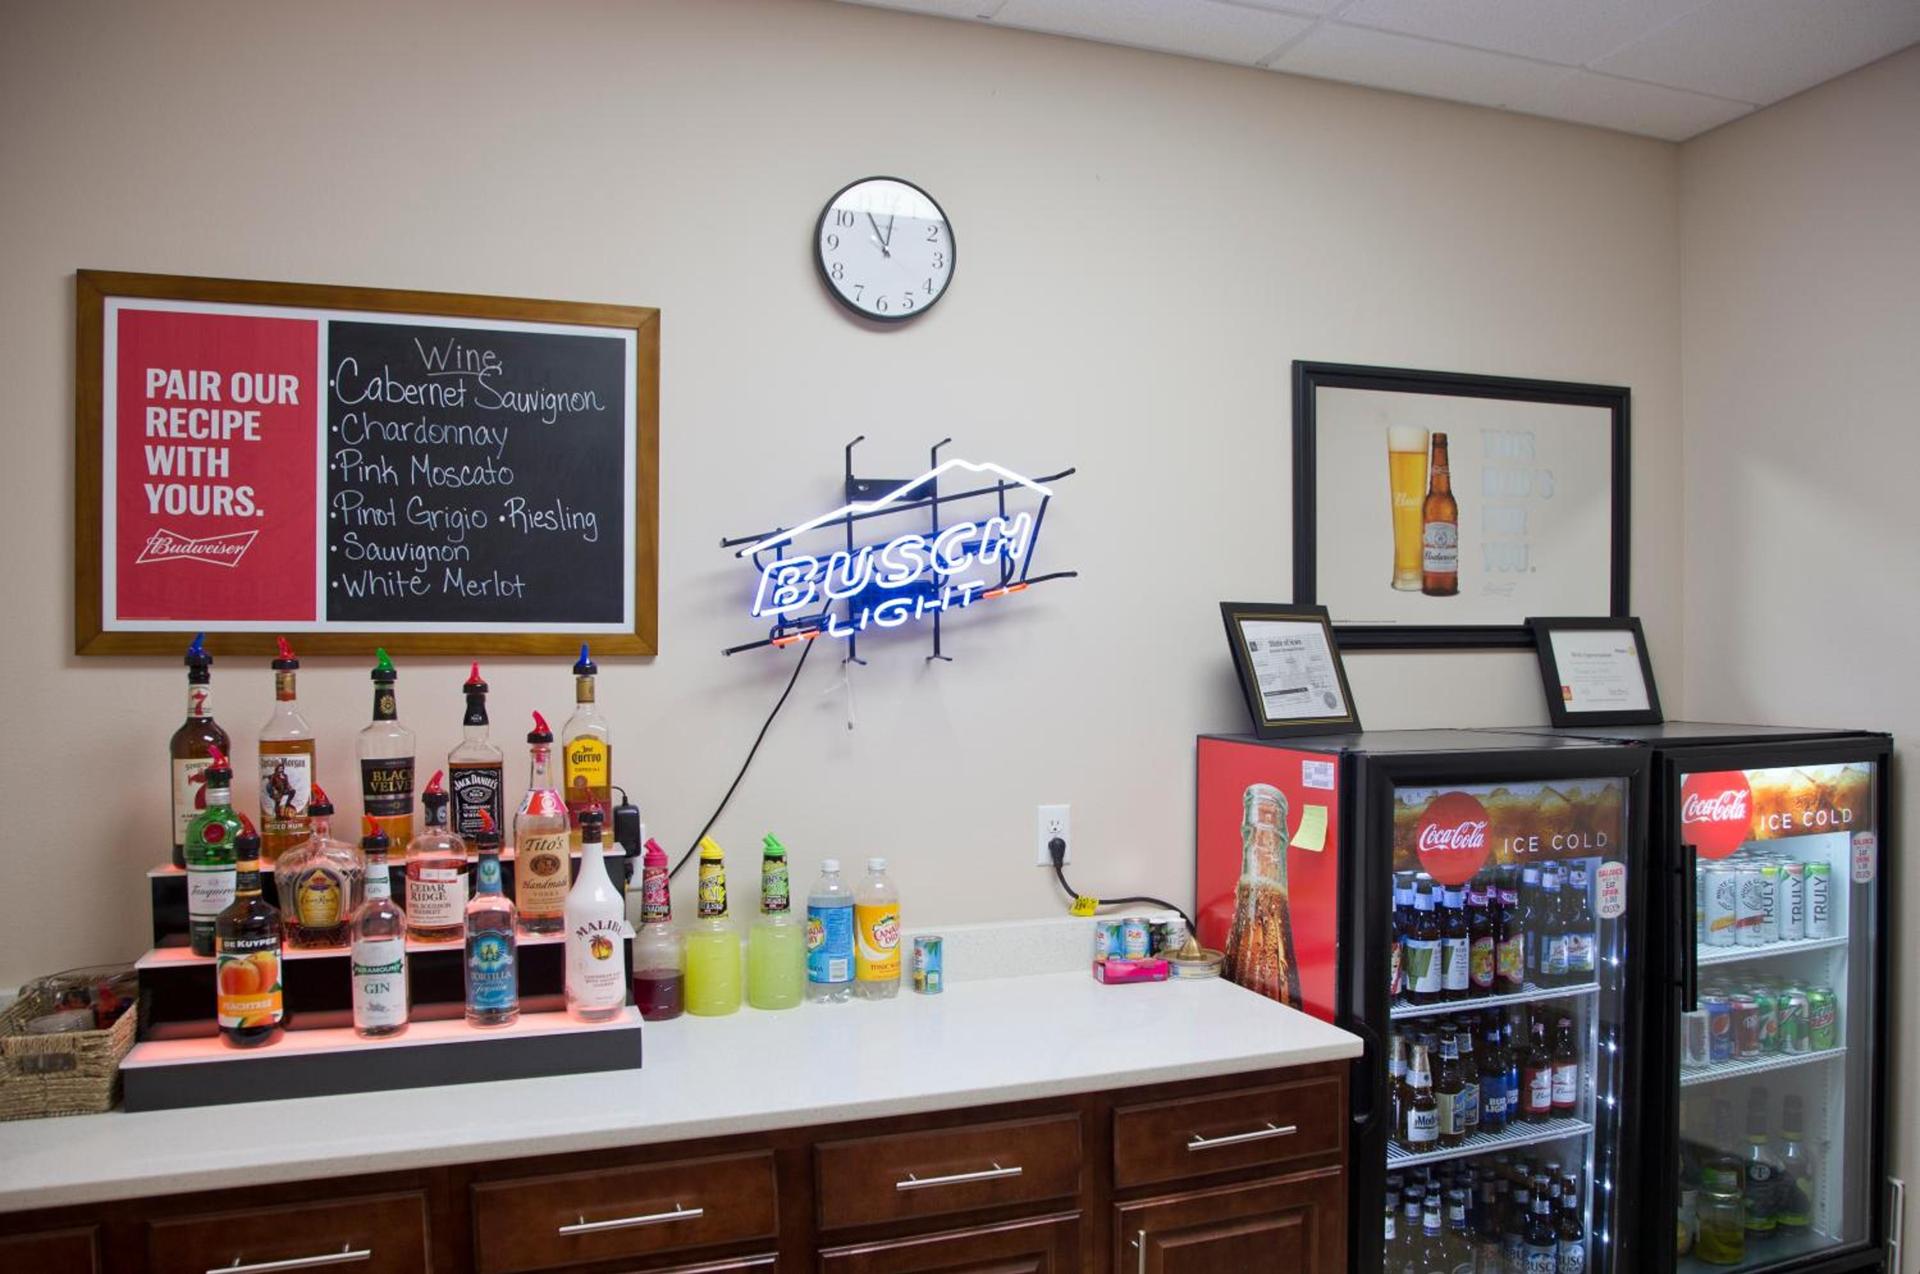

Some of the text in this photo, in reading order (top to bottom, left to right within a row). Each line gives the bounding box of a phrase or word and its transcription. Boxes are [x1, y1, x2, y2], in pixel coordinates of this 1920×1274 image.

[835, 209, 855, 228] 10
[827, 234, 840, 251] 9
[926, 225, 939, 243] 2
[831, 262, 844, 280] 8
[932, 252, 944, 269] 3
[854, 284, 865, 302] 7
[922, 277, 933, 295] 4
[876, 295, 888, 313] 6
[902, 291, 914, 310] 5
[414, 337, 502, 374] Wine
[147, 368, 299, 405] PAIR OUR
[336, 357, 605, 424] Cabernet Sauvignon
[146, 407, 262, 441] RECIPE
[341, 411, 508, 460] Chardonnay
[144, 445, 229, 477] WITH
[336, 448, 514, 488] Pink Moscato
[144, 484, 264, 517] YOURS.
[333, 489, 598, 543] Pinot Grigio Riesling
[147, 536, 245, 555] Budweiser
[343, 531, 470, 573] Sauvignon
[751, 512, 1031, 618] BUSCH
[342, 567, 526, 598] White Merlot
[828, 580, 984, 638] LIGHT
[191, 691, 209, 716] 7
[572, 750, 601, 764] Cuervo
[370, 781, 413, 792] VELVE
[1682, 790, 1749, 823] Coca-Cola
[1761, 808, 1853, 831] ICE COLD
[525, 836, 565, 851] Tito's
[1419, 820, 1488, 851] Coca-Cola
[1504, 832, 1608, 854] ICE COLD
[191, 885, 236, 897] Tanquer
[411, 883, 446, 893] CEDAR
[411, 892, 447, 901] RIDGE
[1763, 880, 1774, 924] TRULY
[1792, 877, 1802, 925] TRULY
[1814, 876, 1828, 924] TRULY
[873, 925, 898, 941] CANA
[364, 983, 390, 994] GIN
